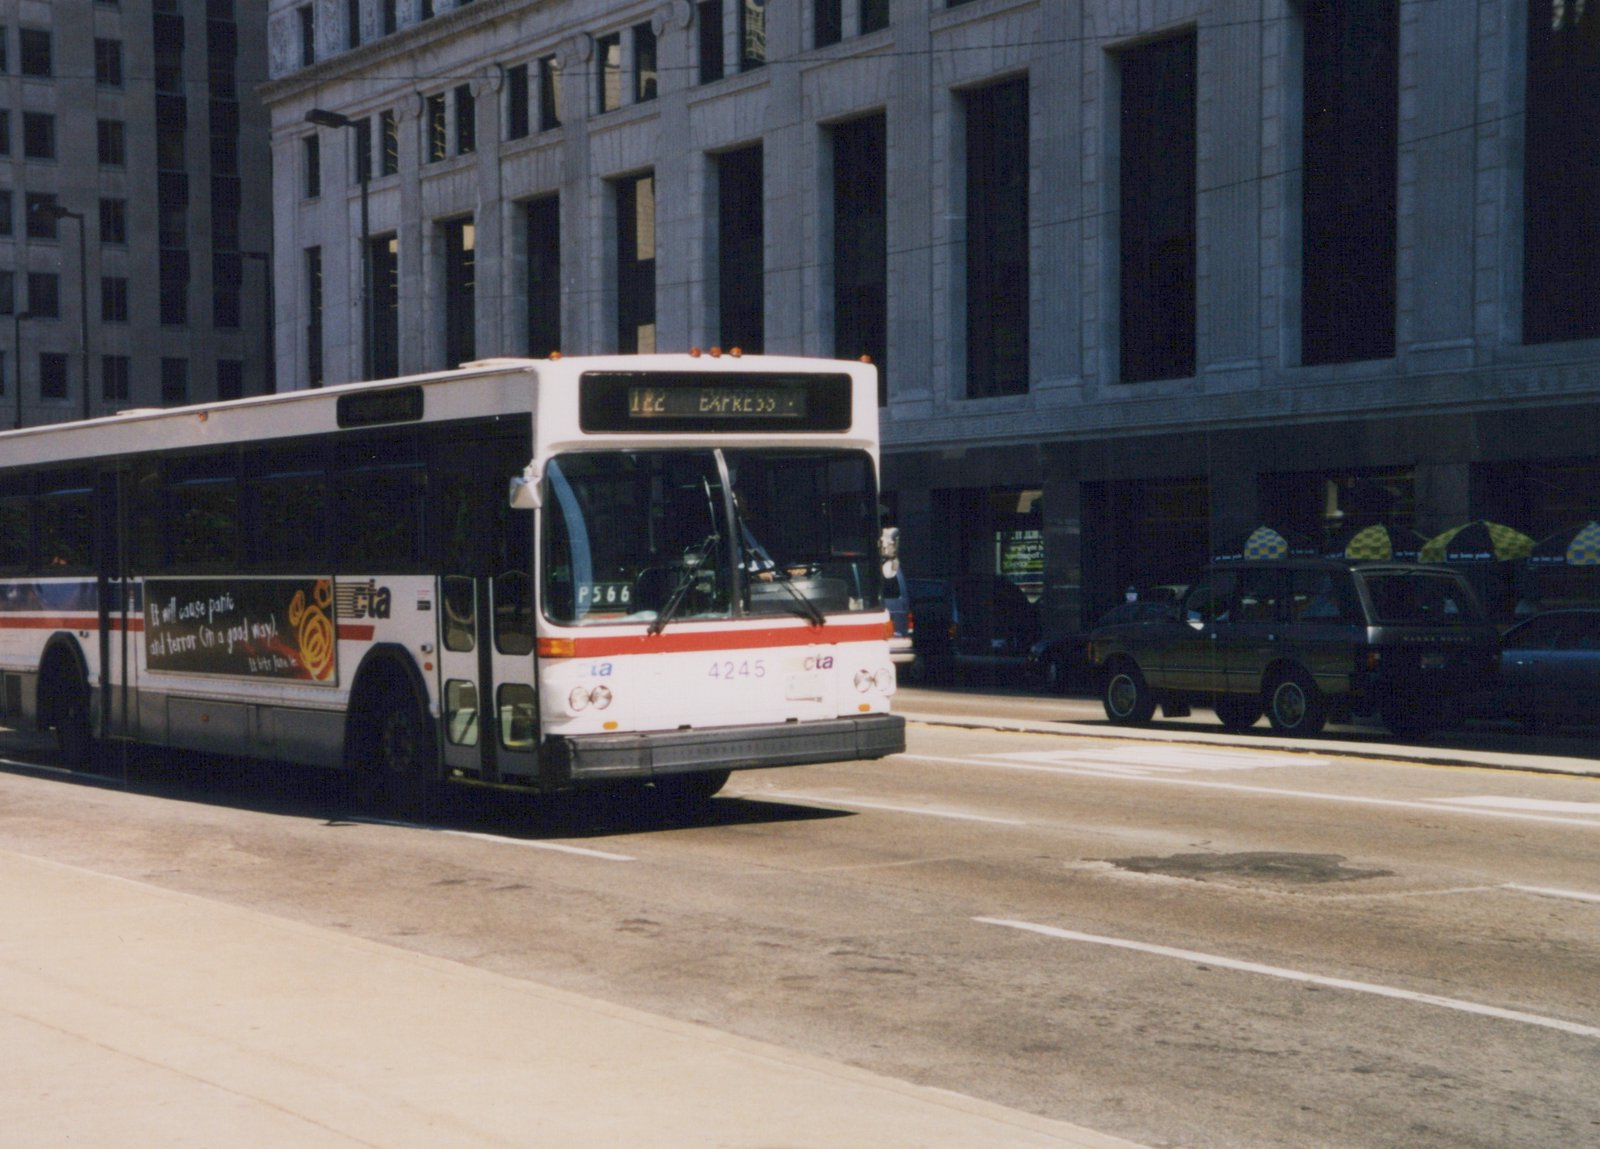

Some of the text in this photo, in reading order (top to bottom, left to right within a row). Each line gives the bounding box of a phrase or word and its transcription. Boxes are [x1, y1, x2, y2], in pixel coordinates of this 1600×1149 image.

[352, 578, 392, 619] cta
[578, 585, 630, 604] P566
[150, 592, 235, 627] It will cause panic
[150, 631, 166, 656] and
[167, 632, 198, 655] terror
[199, 624, 215, 648] (in
[217, 631, 225, 644] a
[227, 617, 249, 655] good
[708, 659, 767, 679] 4245
[803, 653, 834, 672] cta
